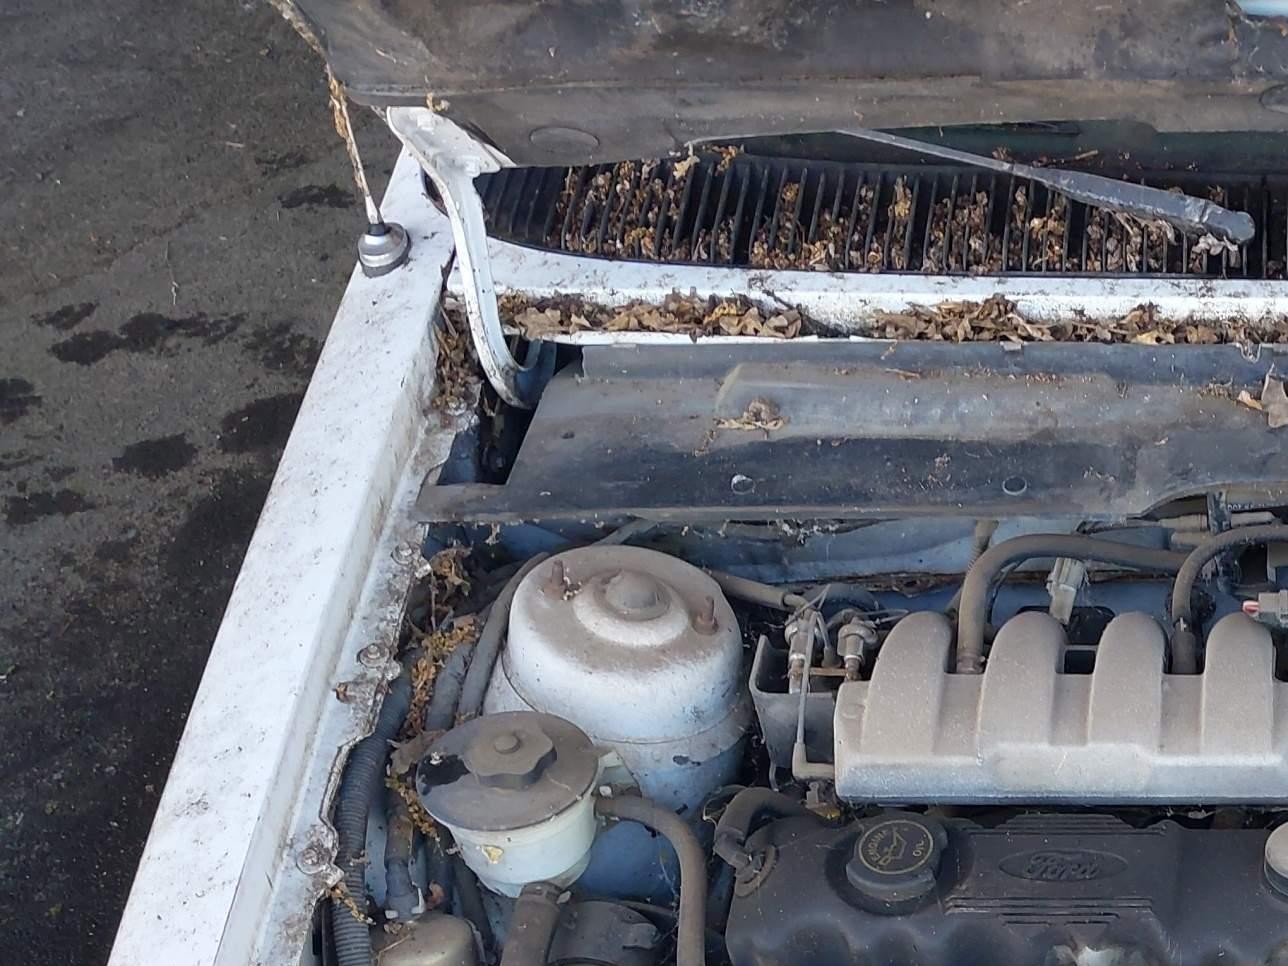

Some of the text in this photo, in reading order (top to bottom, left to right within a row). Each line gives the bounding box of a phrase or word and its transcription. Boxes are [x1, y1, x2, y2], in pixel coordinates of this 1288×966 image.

[868, 829, 888, 861] ENGINE
[912, 840, 924, 857] OIL
[1024, 853, 1099, 880] Ford
